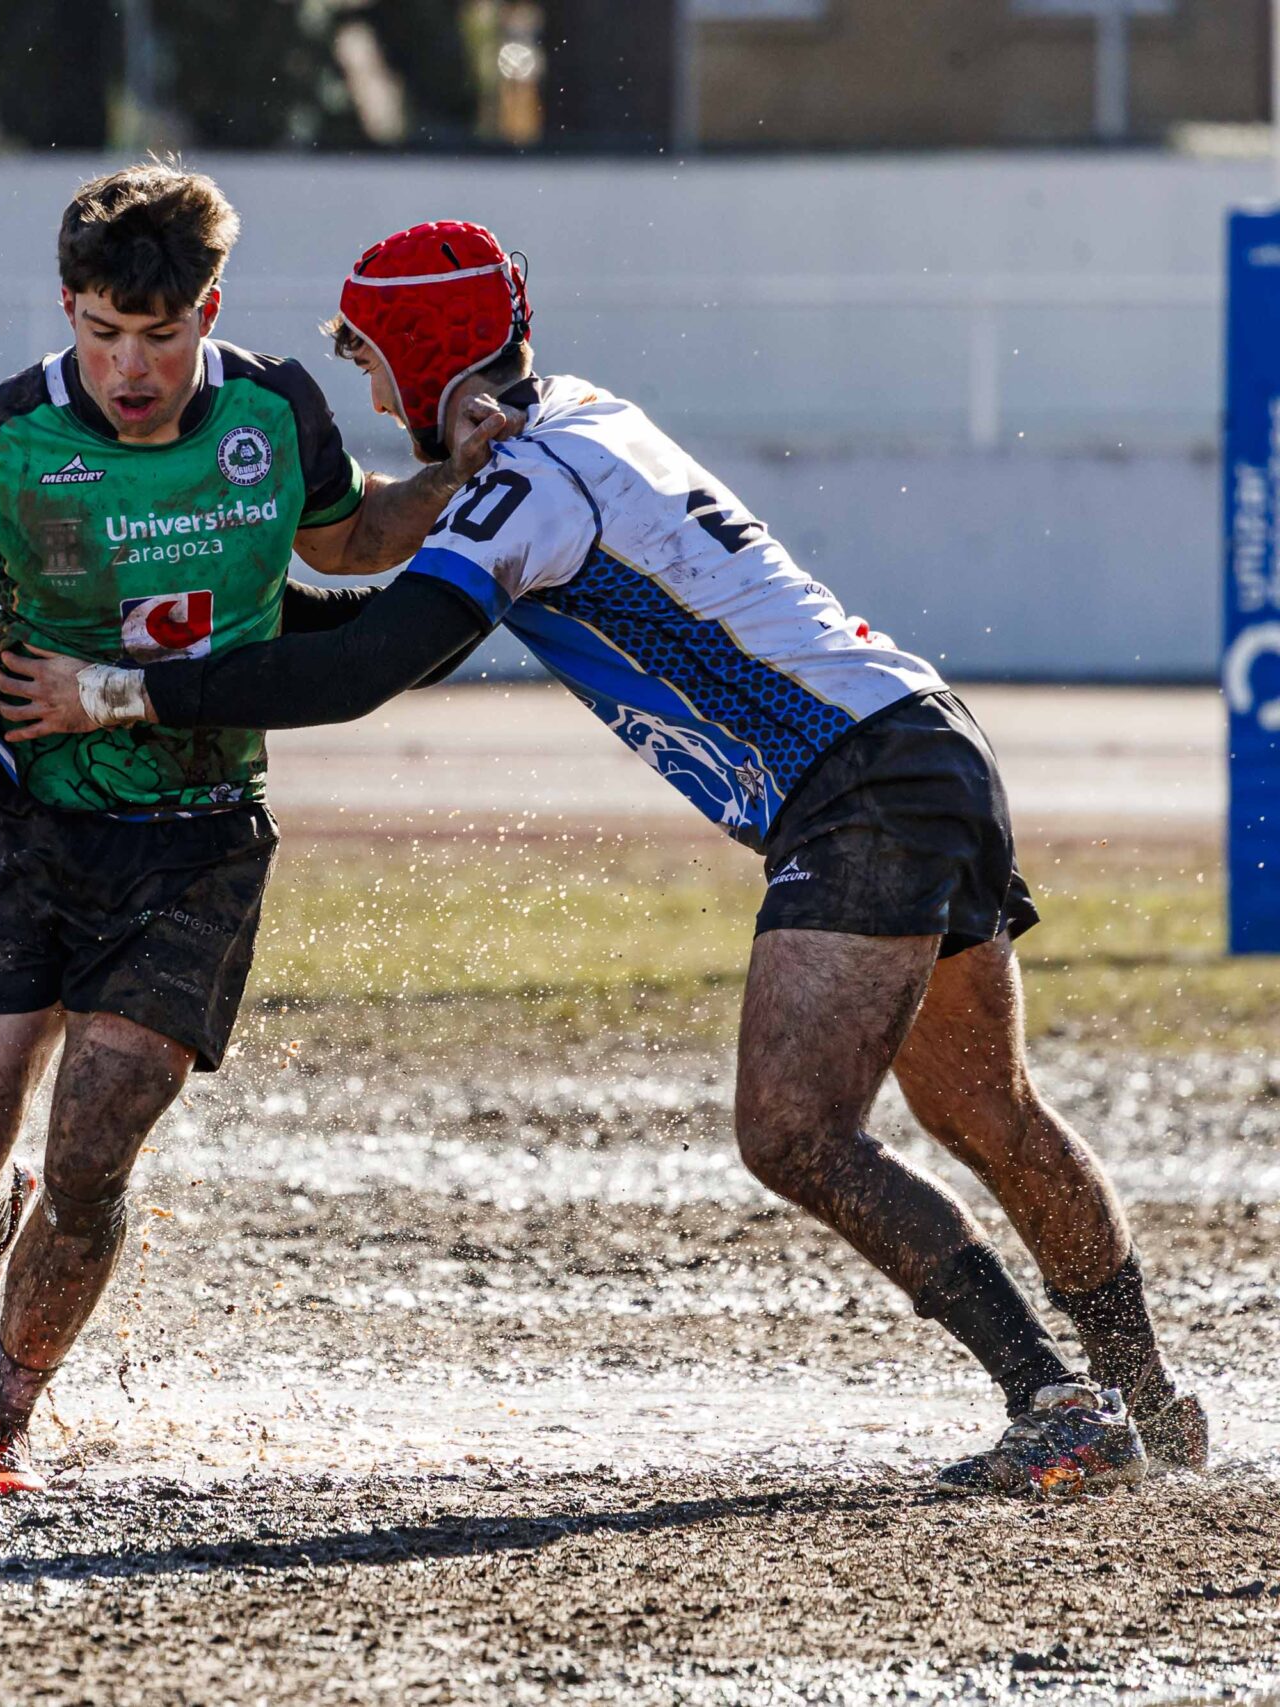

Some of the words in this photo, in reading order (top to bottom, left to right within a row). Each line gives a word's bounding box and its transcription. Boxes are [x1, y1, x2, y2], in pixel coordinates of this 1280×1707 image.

[41, 470, 106, 484] MERCURY
[106, 499, 278, 541] Universidad
[109, 538, 223, 566] Zaragoza
